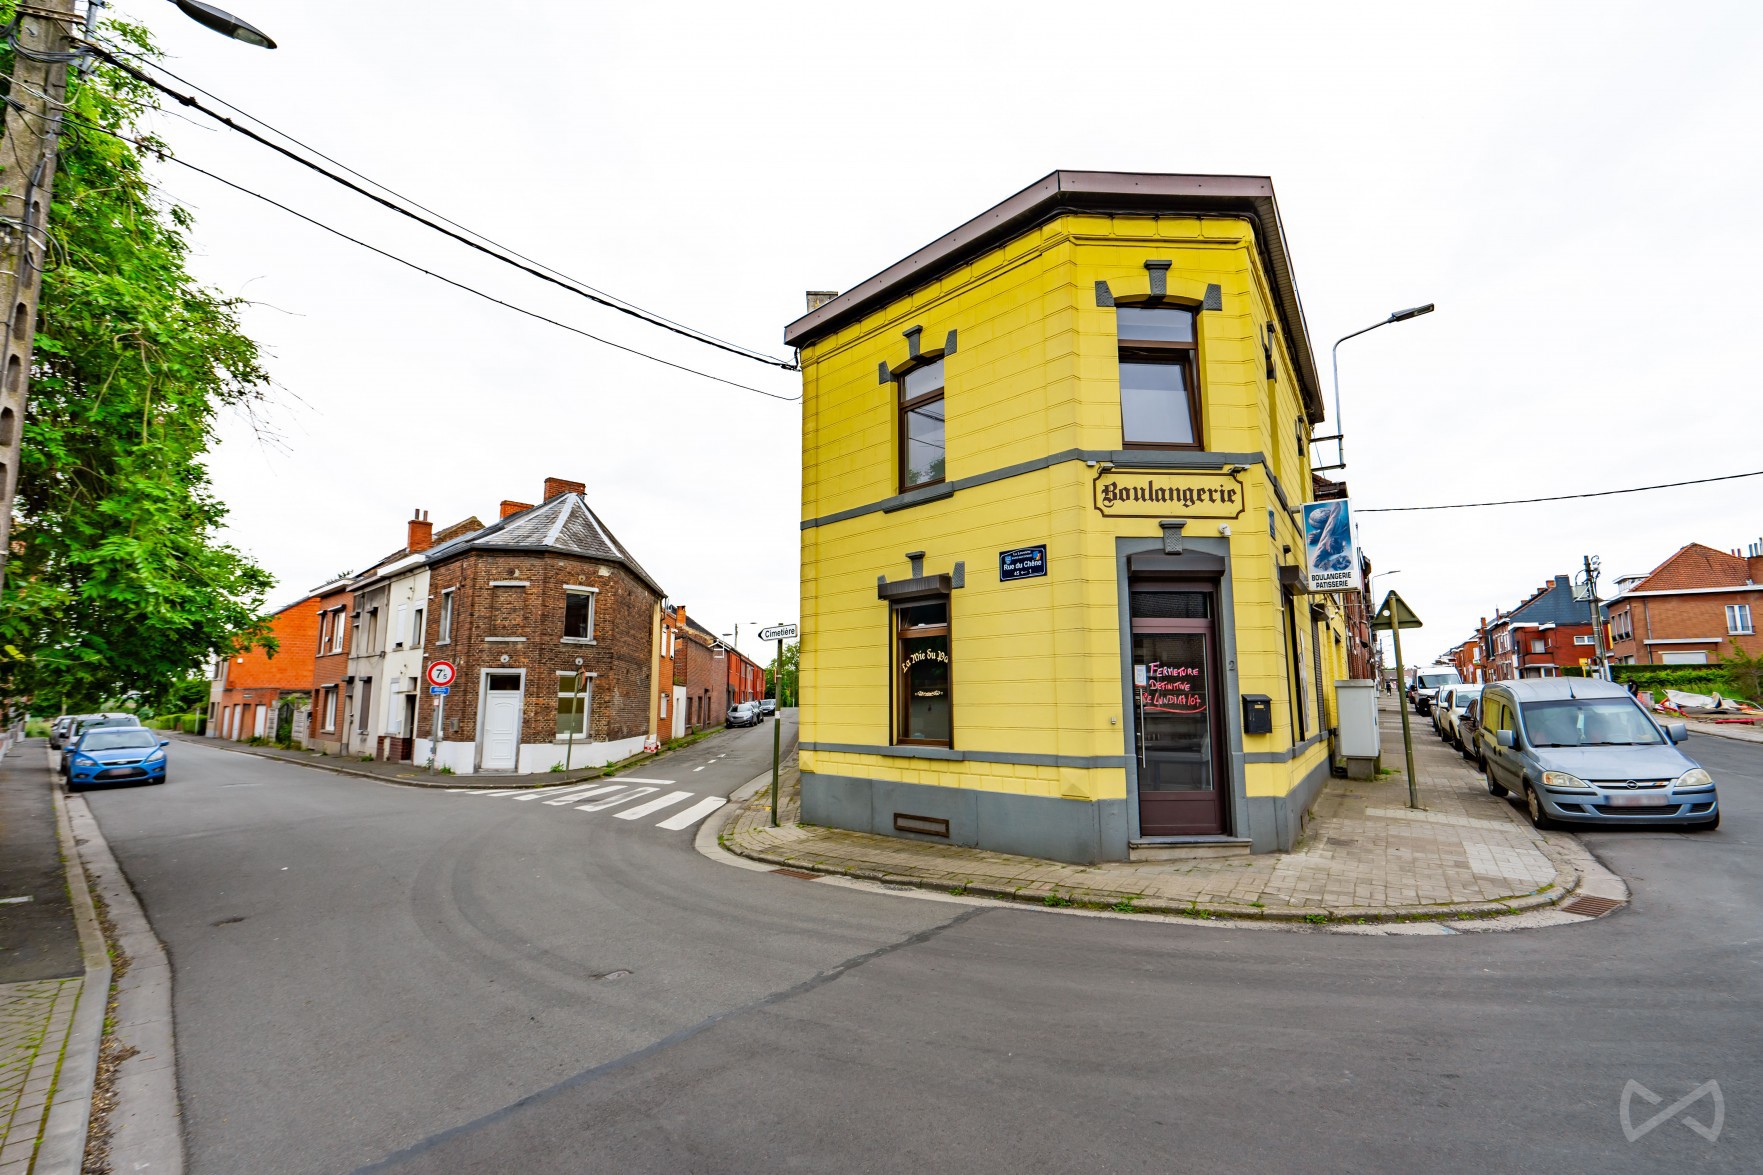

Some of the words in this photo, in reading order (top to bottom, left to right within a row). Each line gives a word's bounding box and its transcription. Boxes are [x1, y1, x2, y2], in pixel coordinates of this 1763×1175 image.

[1101, 480, 1237, 508] Boulangerie
[1023, 559, 1042, 568] Chêne
[1311, 571, 1352, 582] BOULANGERIE
[1315, 579, 1349, 589] PATISSERIE
[764, 627, 796, 639] Cimetière
[901, 659, 912, 674] La
[910, 650, 926, 664] Mie
[926, 648, 936, 660] du
[936, 650, 949, 664] Pa
[1228, 660, 1236, 672] 2
[1148, 661, 1199, 677] FERMETURE
